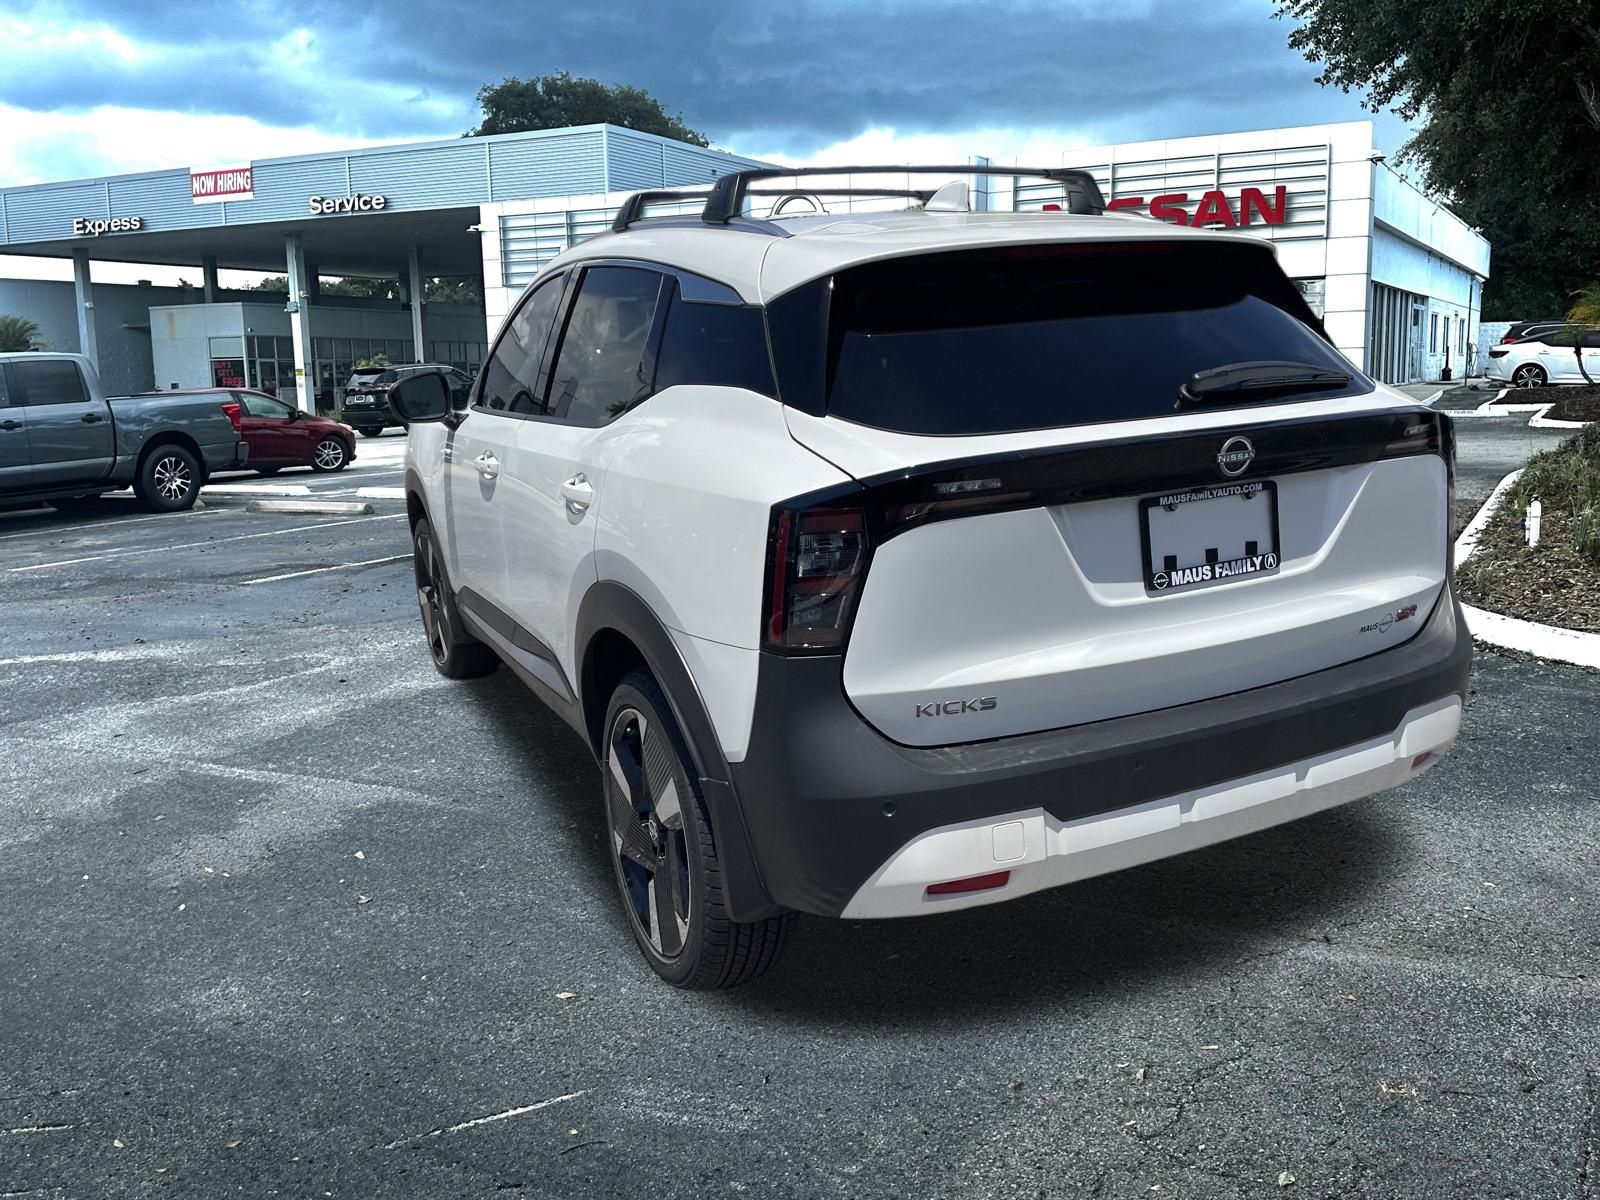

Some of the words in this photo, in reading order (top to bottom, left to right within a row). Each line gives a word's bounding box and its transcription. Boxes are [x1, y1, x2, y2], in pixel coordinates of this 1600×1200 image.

[192, 174, 216, 195] NOW
[217, 171, 252, 192] HIRING
[309, 192, 386, 215] Service
[73, 216, 142, 237] Express
[223, 377, 244, 387] FREE
[1217, 450, 1255, 463] NISSAN
[1160, 482, 1263, 506] MAUSFAMILYAUTO.COM
[1171, 565, 1212, 586] MAUS
[1214, 555, 1263, 578] FAMILY
[1359, 622, 1380, 633] MAUS
[916, 696, 998, 718] KICKS
